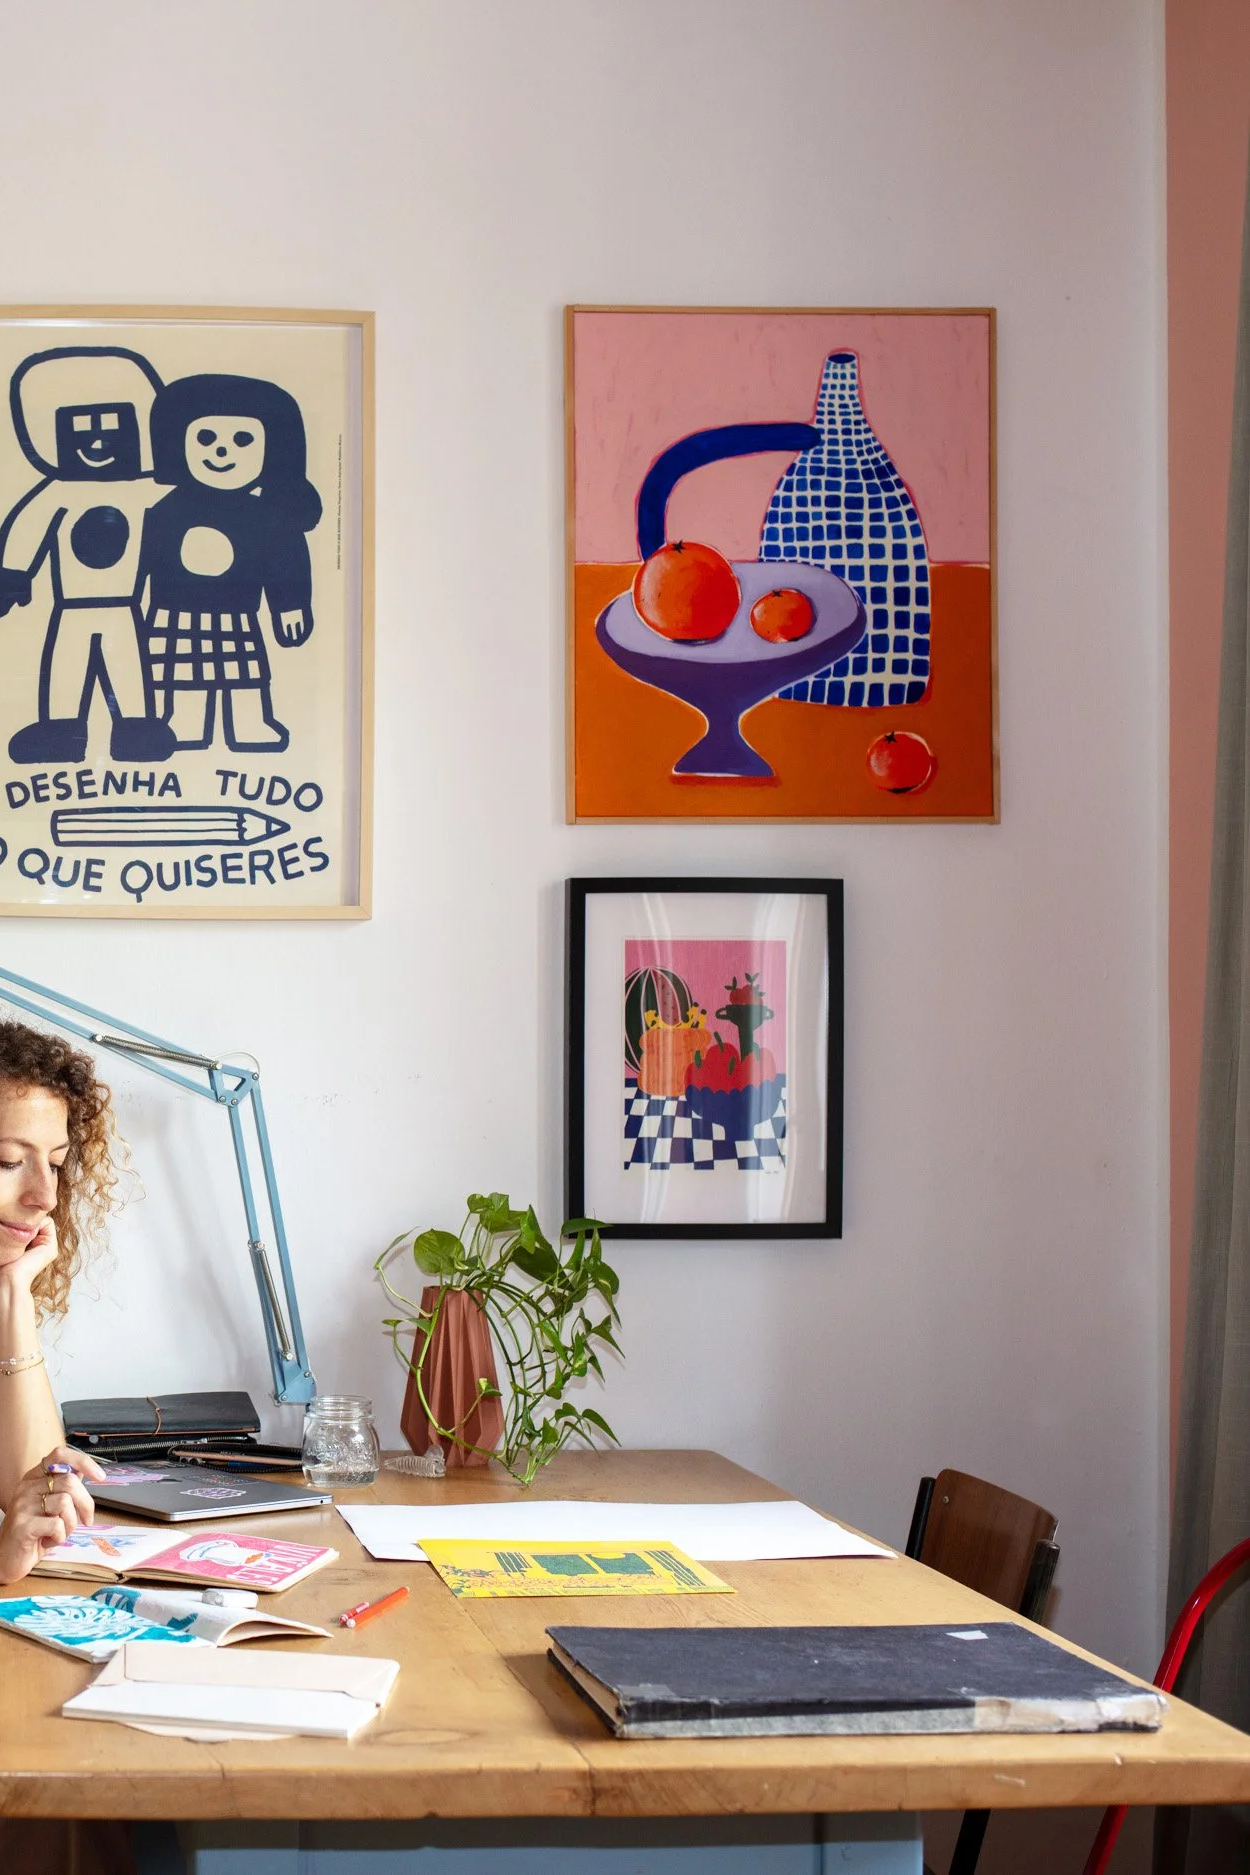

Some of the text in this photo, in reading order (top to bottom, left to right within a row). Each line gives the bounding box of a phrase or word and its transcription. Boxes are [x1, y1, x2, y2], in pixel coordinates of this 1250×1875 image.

[5, 769, 323, 812] DESENHA TUDO
[18, 848, 105, 892] QUE
[120, 836, 330, 903] QUISERES
